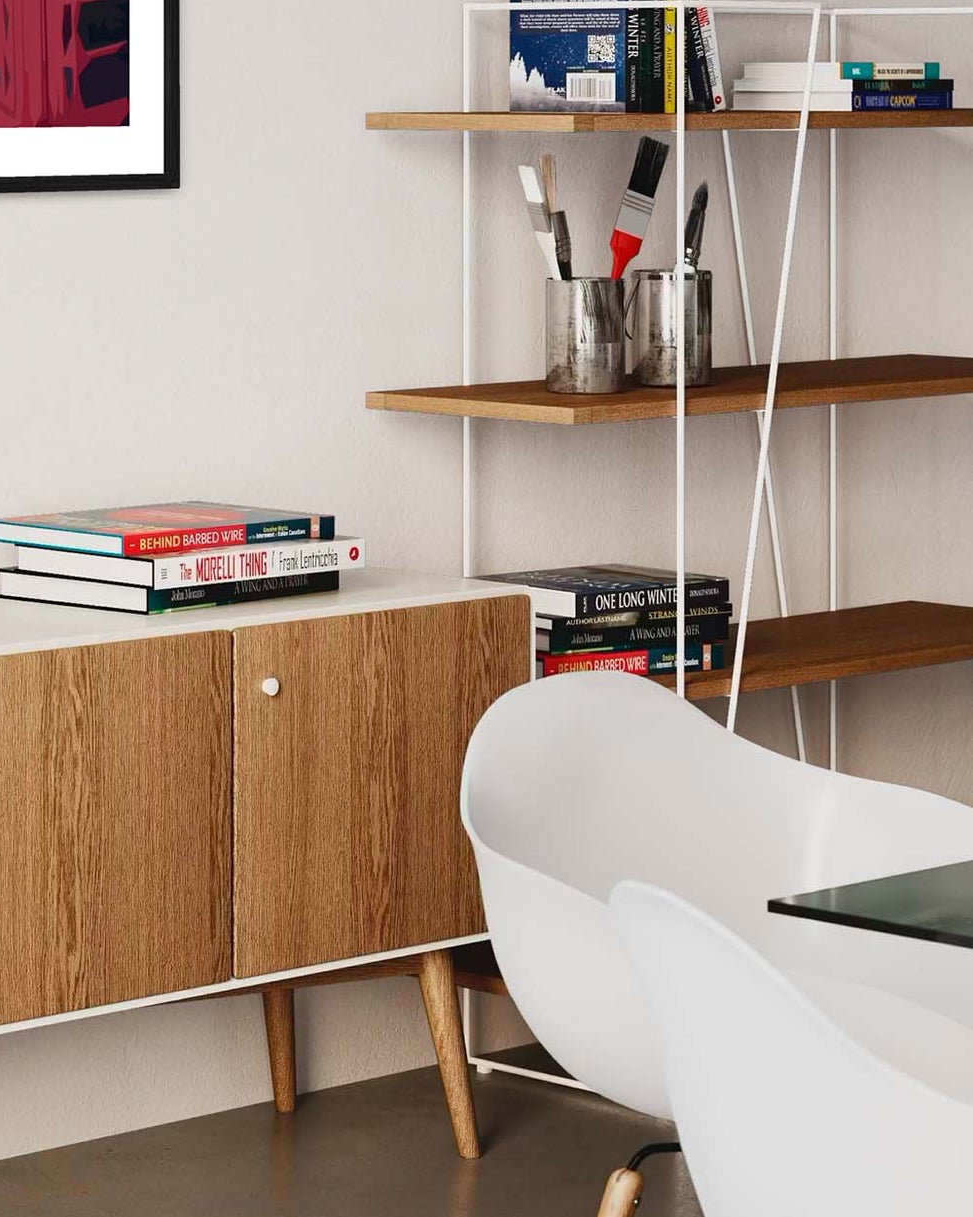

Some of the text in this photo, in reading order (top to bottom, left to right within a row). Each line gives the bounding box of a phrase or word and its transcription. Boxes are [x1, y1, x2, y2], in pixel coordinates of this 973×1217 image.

[696, 6, 710, 28] HING
[627, 14, 639, 58] WINTER
[690, 14, 704, 59] WINTER
[653, 52, 662, 78] PRAYER
[139, 535, 180, 550] BEHIND
[182, 532, 219, 546] BARBED
[221, 529, 244, 543] WIRE
[180, 563, 192, 581] The
[196, 555, 236, 582] MORELLI
[239, 551, 267, 577] THING
[279, 551, 299, 571] Frank
[300, 547, 338, 570] Lentricchia
[240, 579, 261, 593] WING
[262, 578, 278, 590] AND
[595, 594, 616, 611] ONE
[618, 591, 645, 608] LONG
[647, 588, 677, 605] WINTE
[566, 618, 593, 626] AUTHOR
[649, 607, 719, 620] STRAN WINDS
[636, 627, 656, 640] WING
[656, 626, 671, 637] AND
[626, 656, 646, 671] WIRE
